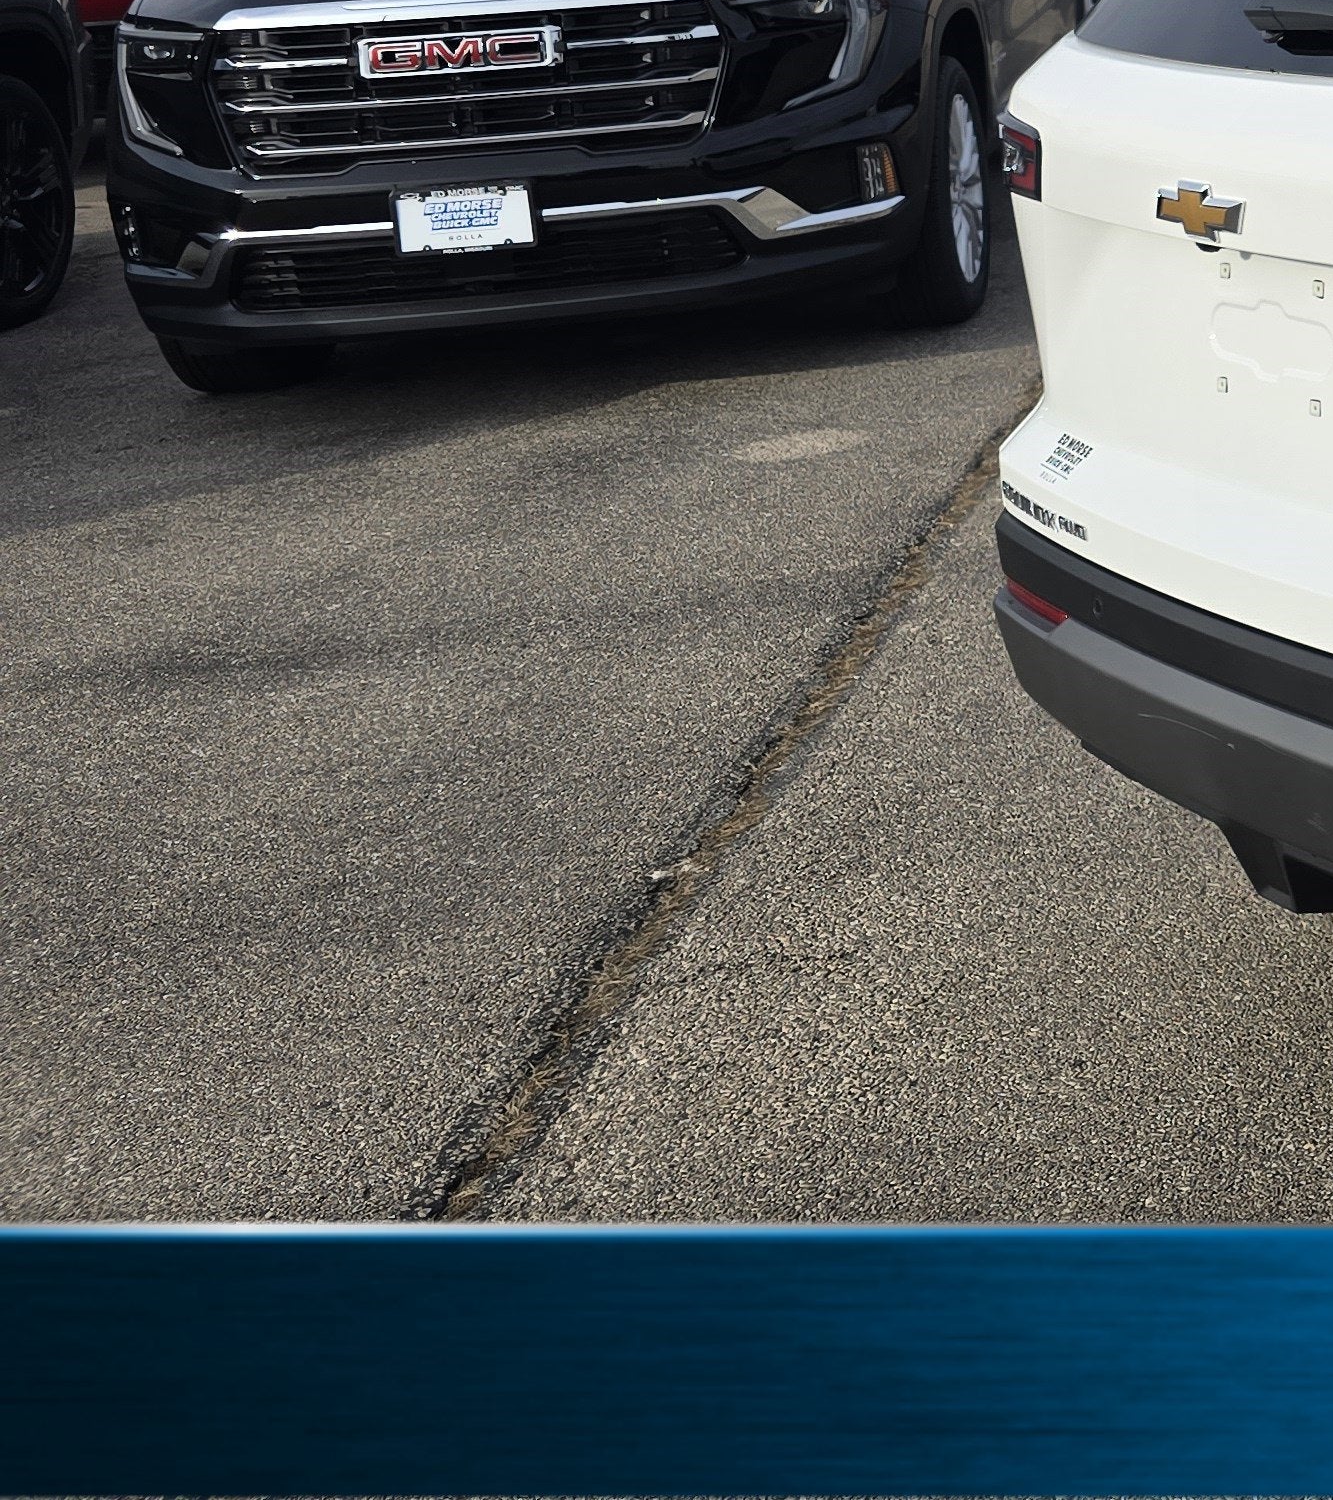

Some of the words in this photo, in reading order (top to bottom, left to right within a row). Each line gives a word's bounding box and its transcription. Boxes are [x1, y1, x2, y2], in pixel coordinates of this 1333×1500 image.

[368, 33, 541, 73] GMC
[424, 202, 446, 216] ED
[446, 198, 502, 212] MORSE
[431, 209, 498, 222] CHEVROLET
